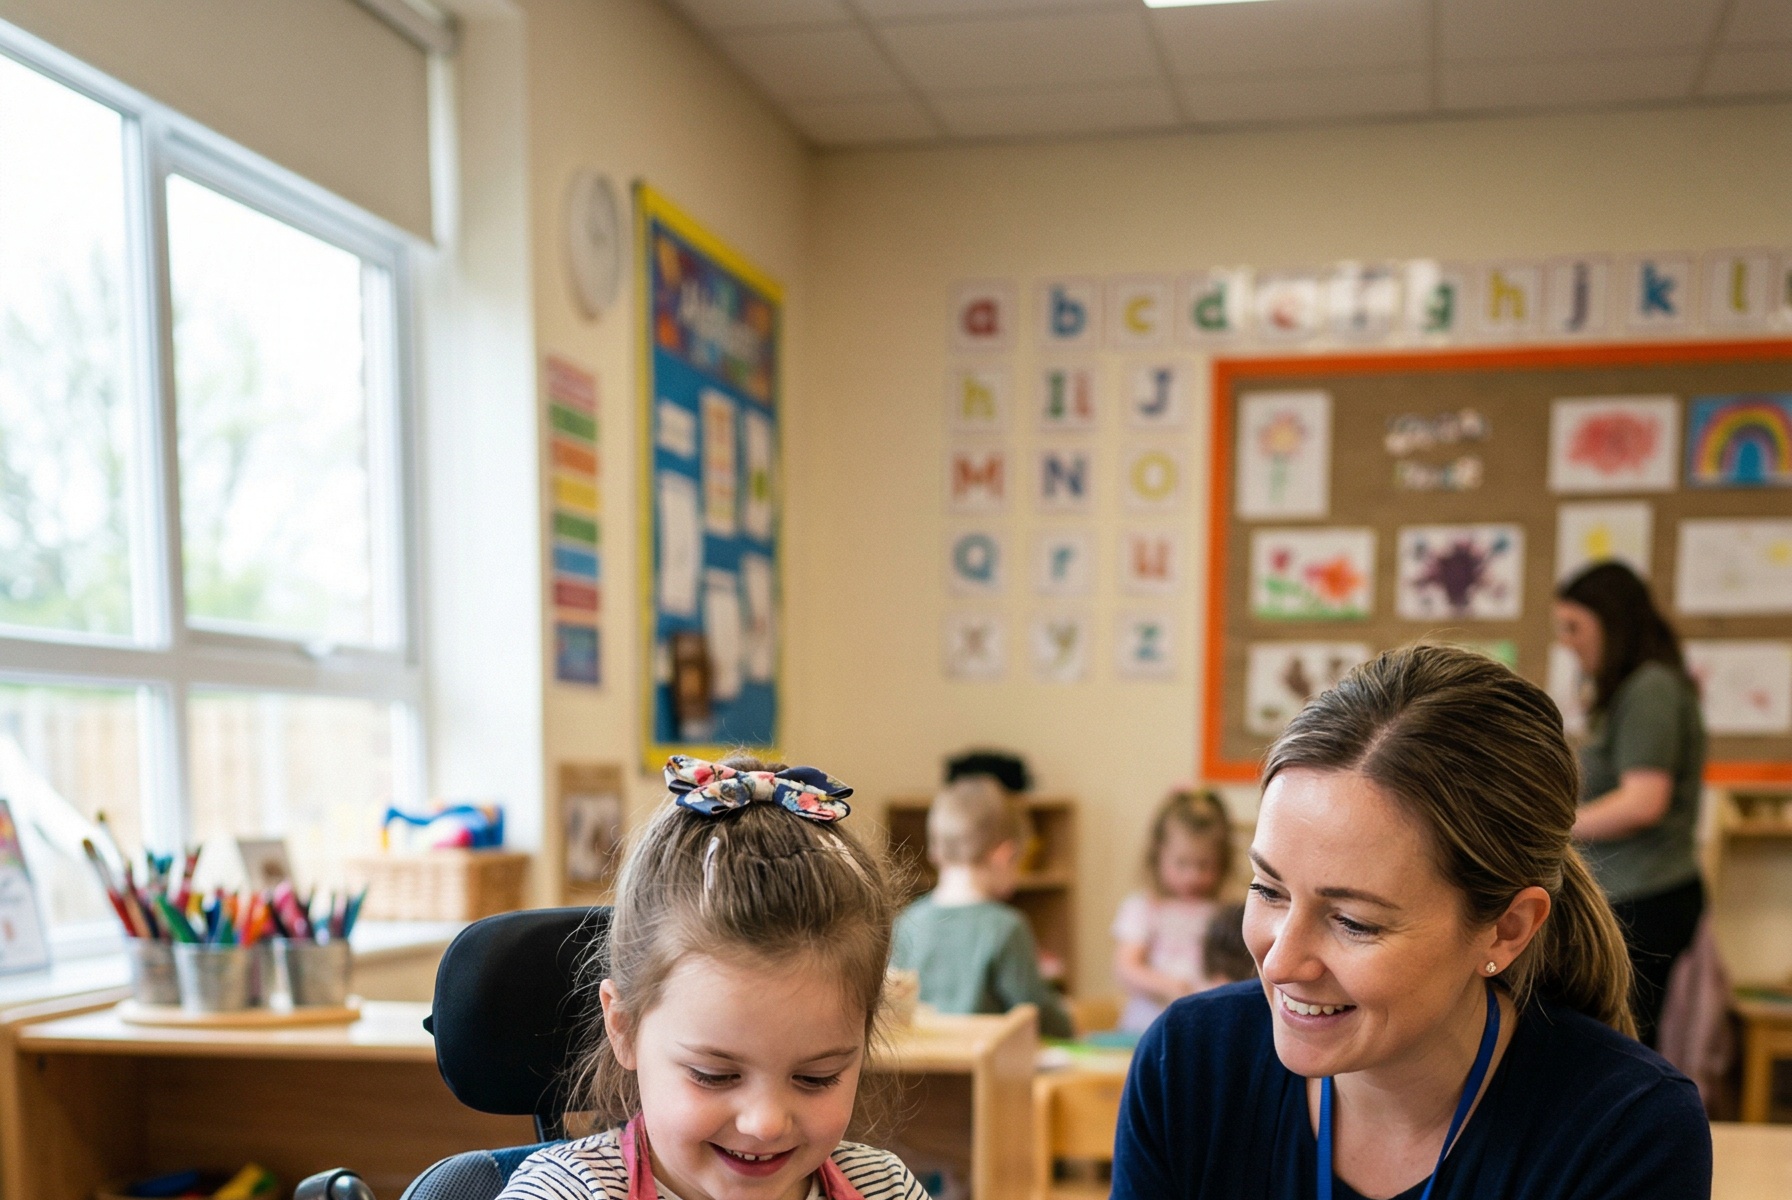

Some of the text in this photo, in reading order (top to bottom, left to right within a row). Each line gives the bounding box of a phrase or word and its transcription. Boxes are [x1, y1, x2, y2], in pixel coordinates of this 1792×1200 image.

[963, 298, 1001, 337] a
[1050, 284, 1087, 339] b
[1123, 295, 1154, 334] c
[1193, 281, 1229, 331] d
[1489, 270, 1526, 321] h
[1642, 262, 1675, 316] k
[960, 375, 995, 420] h
[953, 455, 1004, 498] M
[1043, 454, 1085, 498] N
